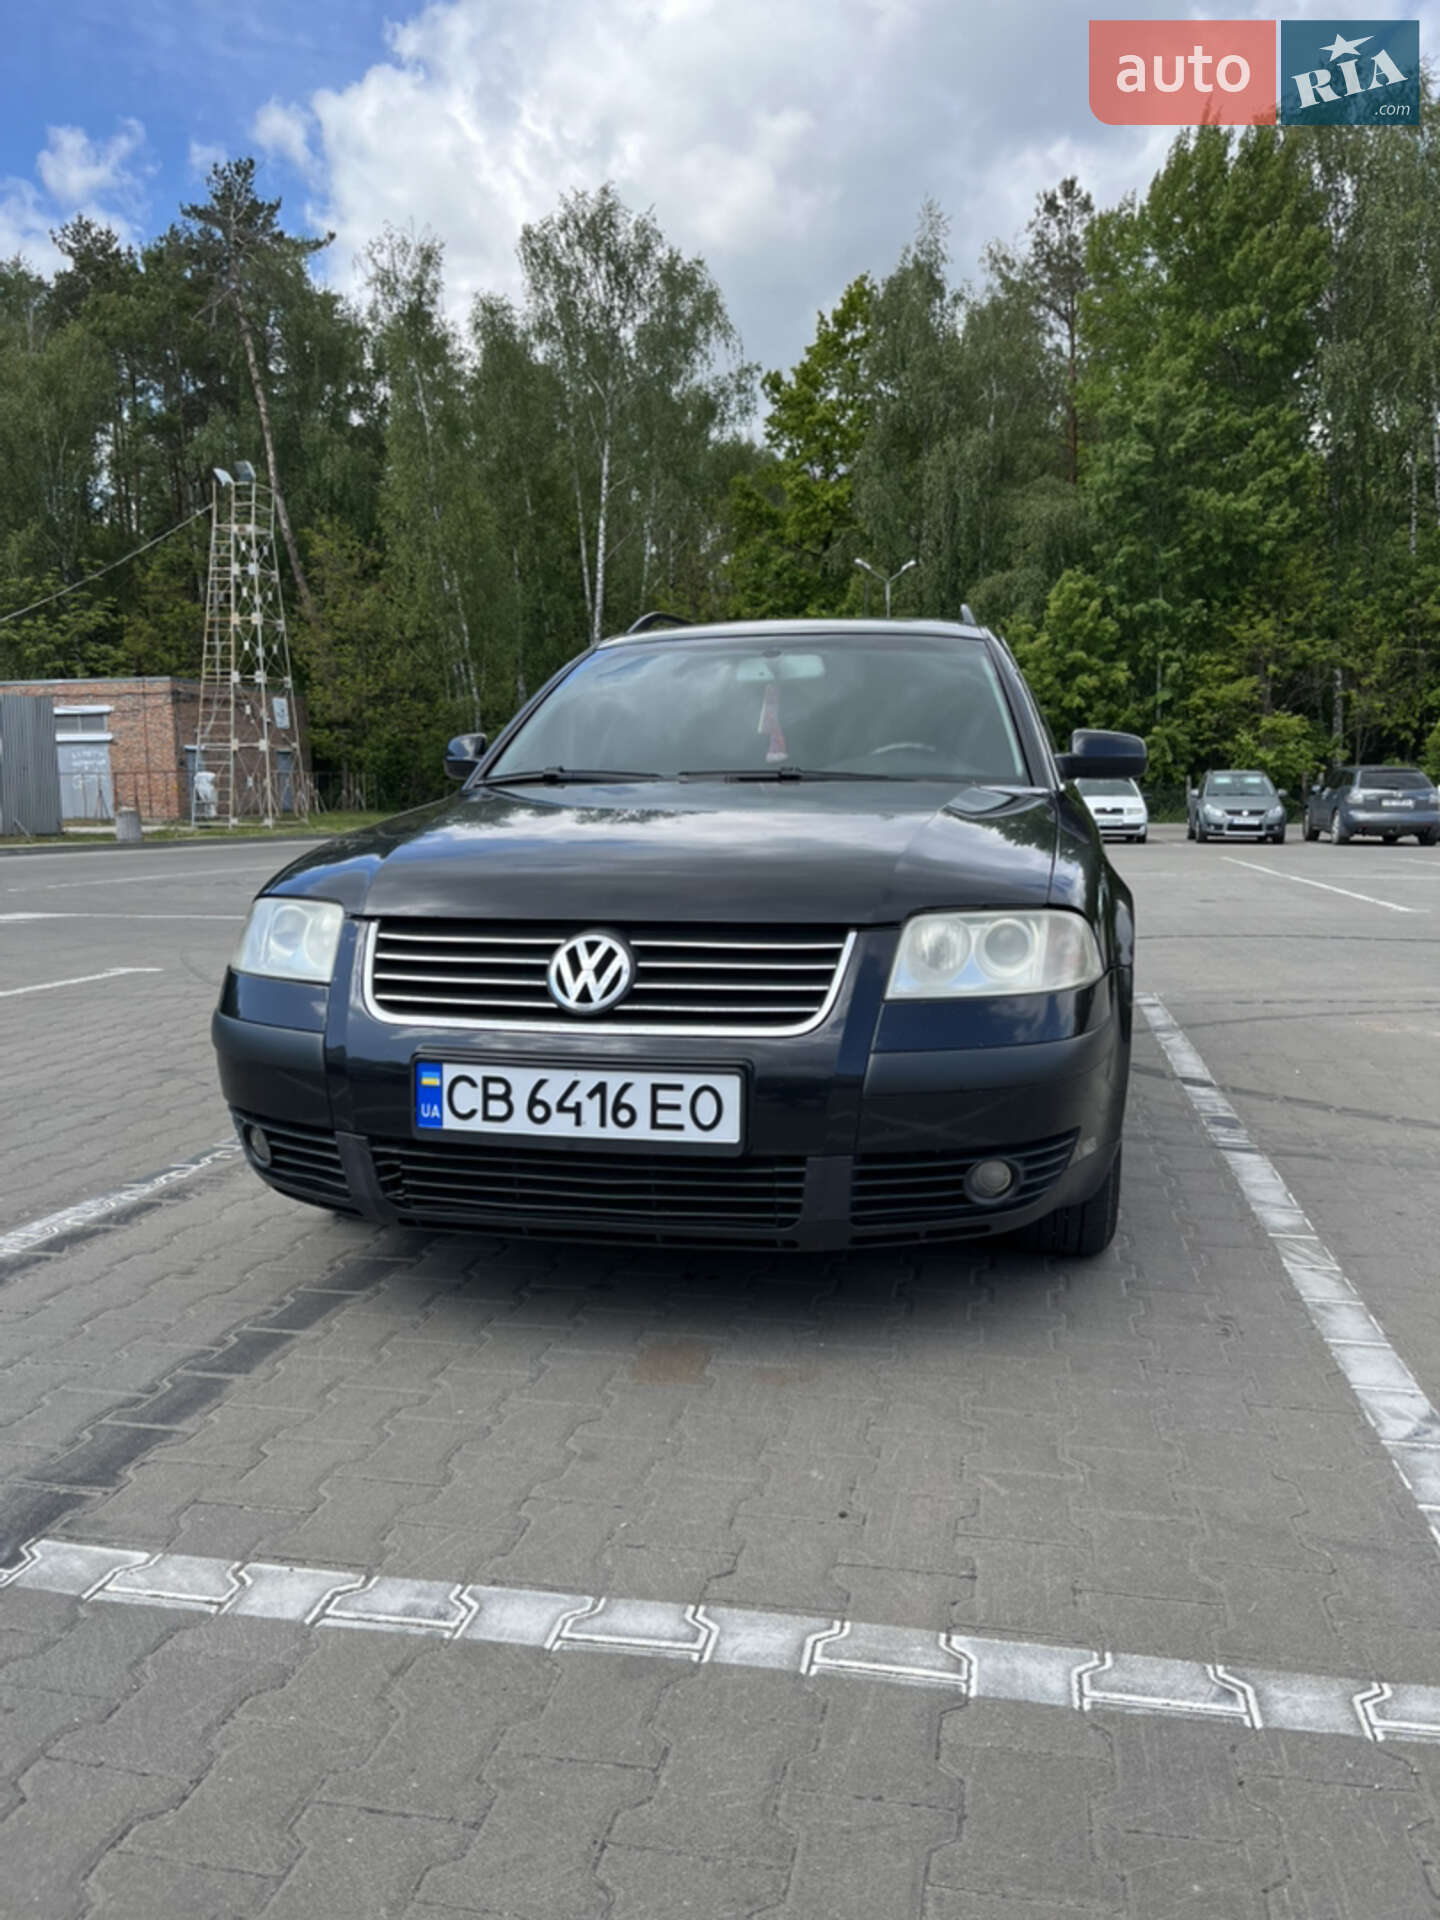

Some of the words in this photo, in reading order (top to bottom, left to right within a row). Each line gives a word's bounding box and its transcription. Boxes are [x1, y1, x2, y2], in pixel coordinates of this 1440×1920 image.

[421, 1103, 441, 1119] UA
[447, 1074, 514, 1123] CB
[526, 1078, 637, 1129] 6416
